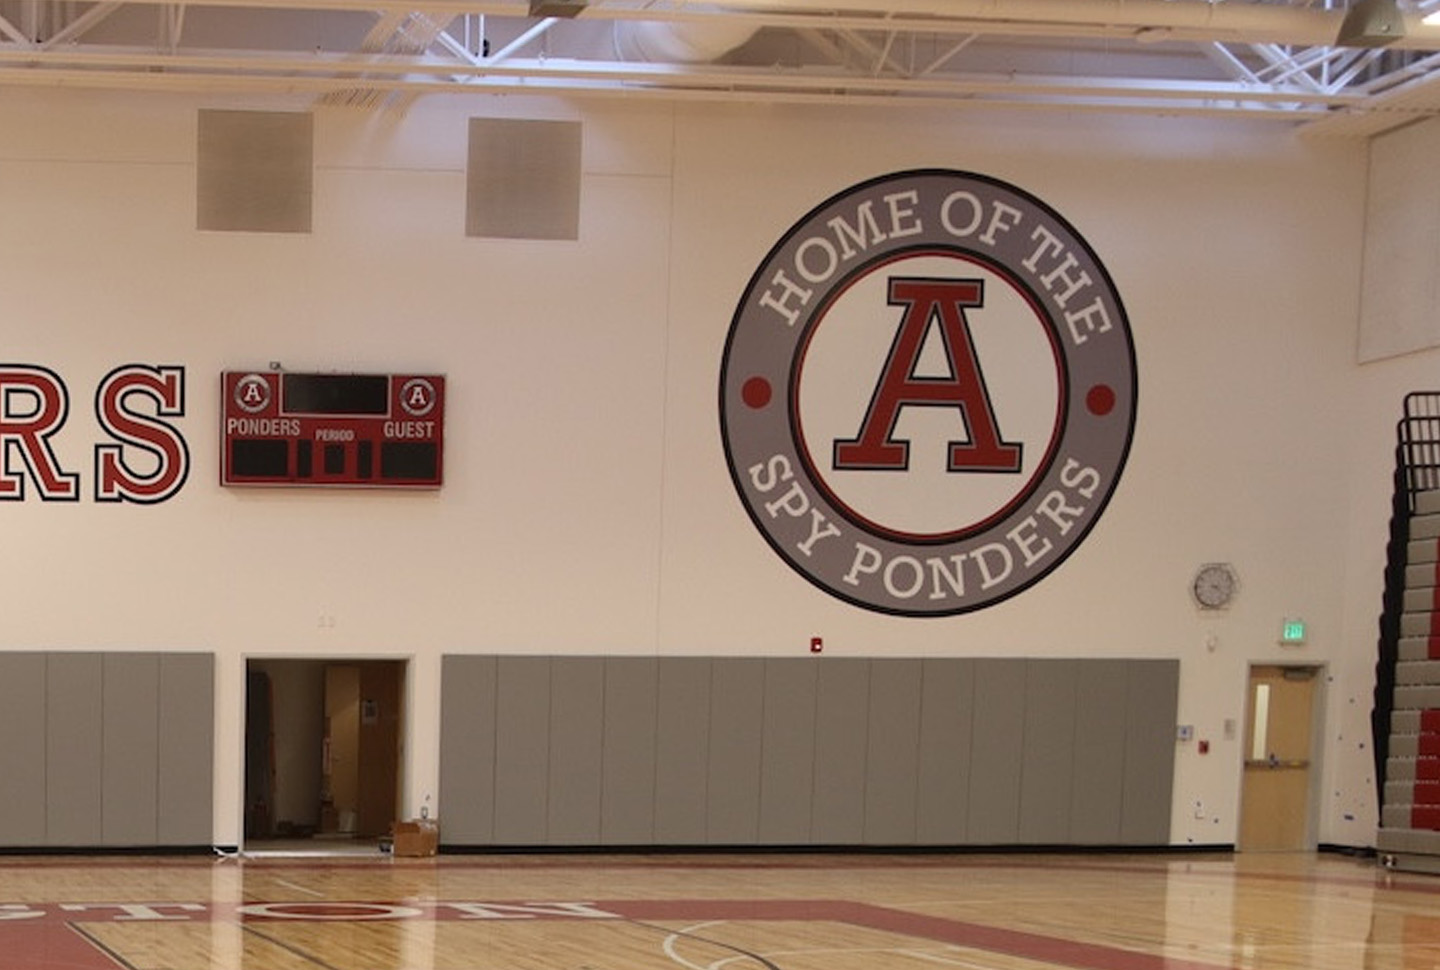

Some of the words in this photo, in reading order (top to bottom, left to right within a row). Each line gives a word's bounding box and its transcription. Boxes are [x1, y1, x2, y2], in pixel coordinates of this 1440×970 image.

[759, 190, 923, 326] HOME
[940, 191, 1022, 245] OF
[1021, 225, 1113, 345] THE
[832, 277, 1023, 473] A
[243, 383, 262, 401] A
[409, 386, 427, 405] A
[227, 418, 301, 436] PONDERS
[315, 429, 355, 442] PERIOD
[384, 421, 436, 438] GUEST
[748, 453, 841, 556] SPY
[842, 458, 1102, 601] PONDERS
